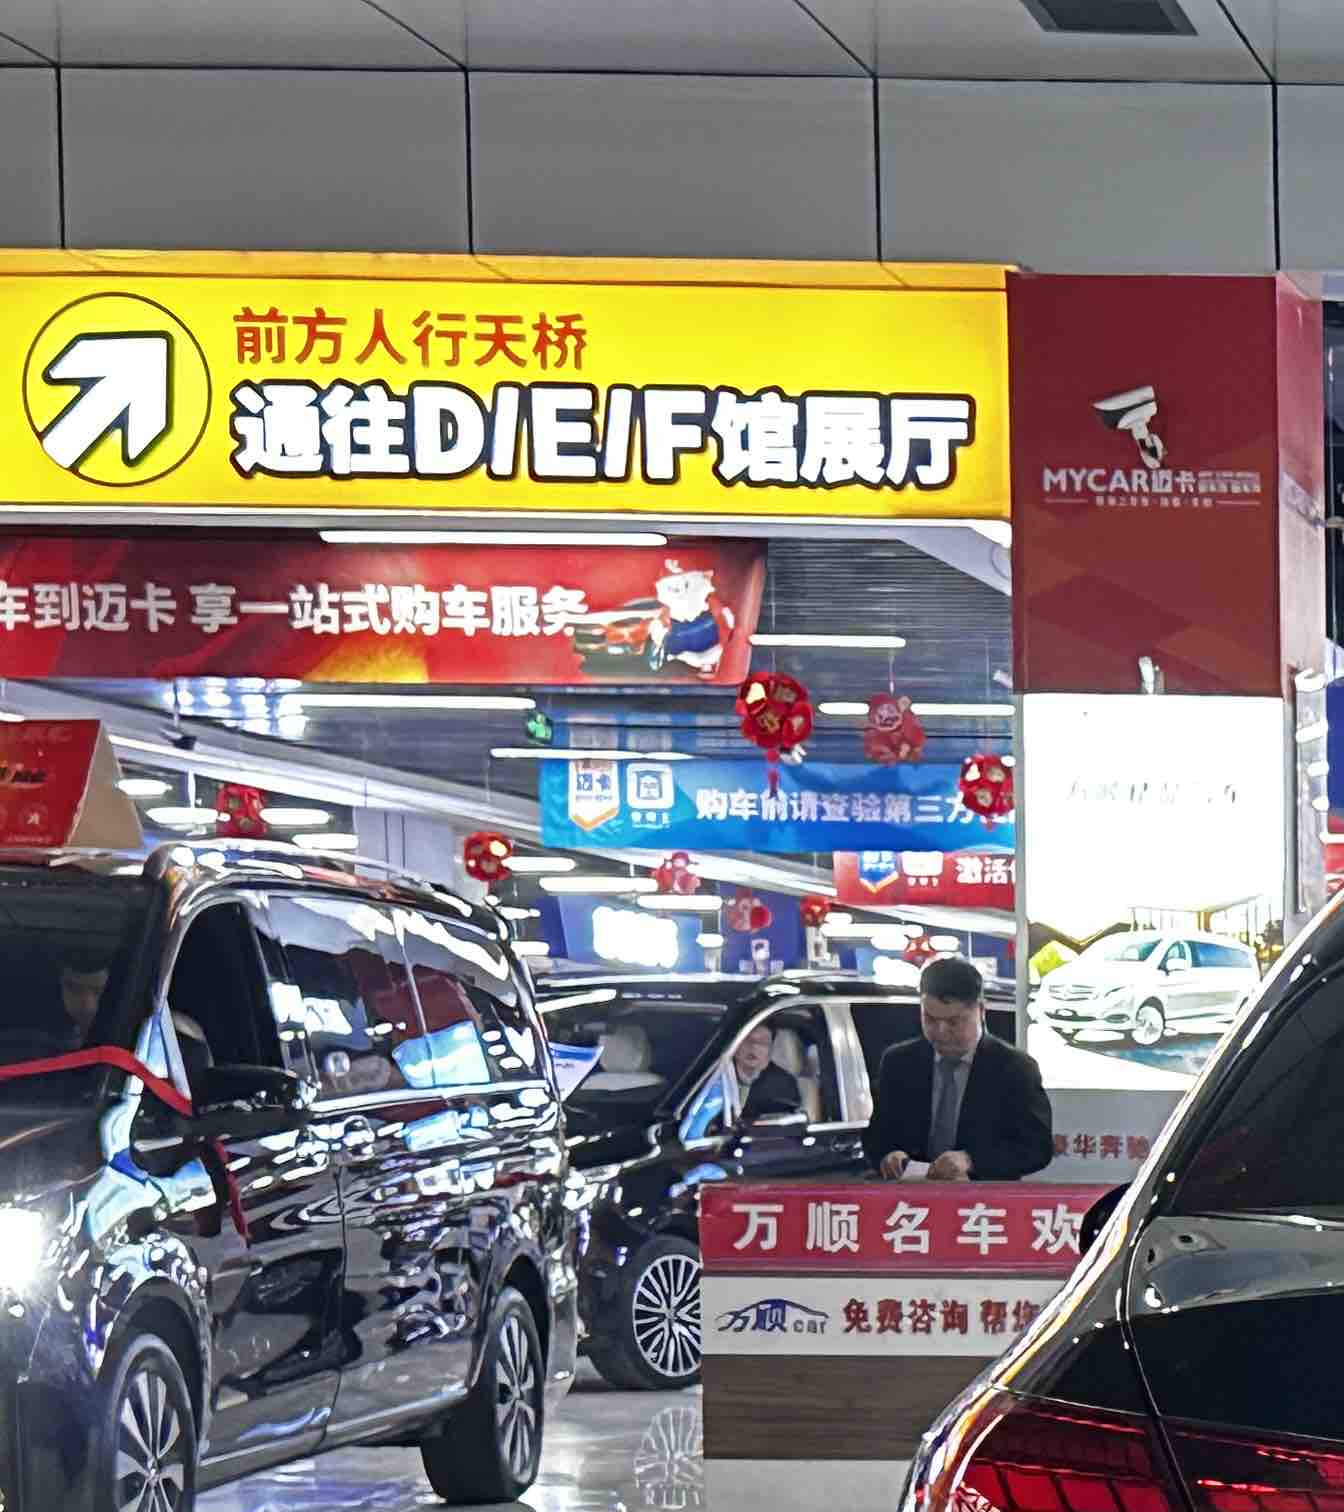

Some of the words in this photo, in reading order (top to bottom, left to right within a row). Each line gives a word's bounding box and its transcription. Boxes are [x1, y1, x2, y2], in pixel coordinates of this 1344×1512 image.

[234, 307, 588, 370] 前方人行天桥
[230, 378, 976, 491] 通往D/E/F馆展厅
[189, 583, 590, 637] 享一站式购车服务
[955, 855, 1014, 885] 激活
[732, 1201, 1081, 1255] 万顺名车欢
[842, 1298, 969, 1336] 免费咨询
